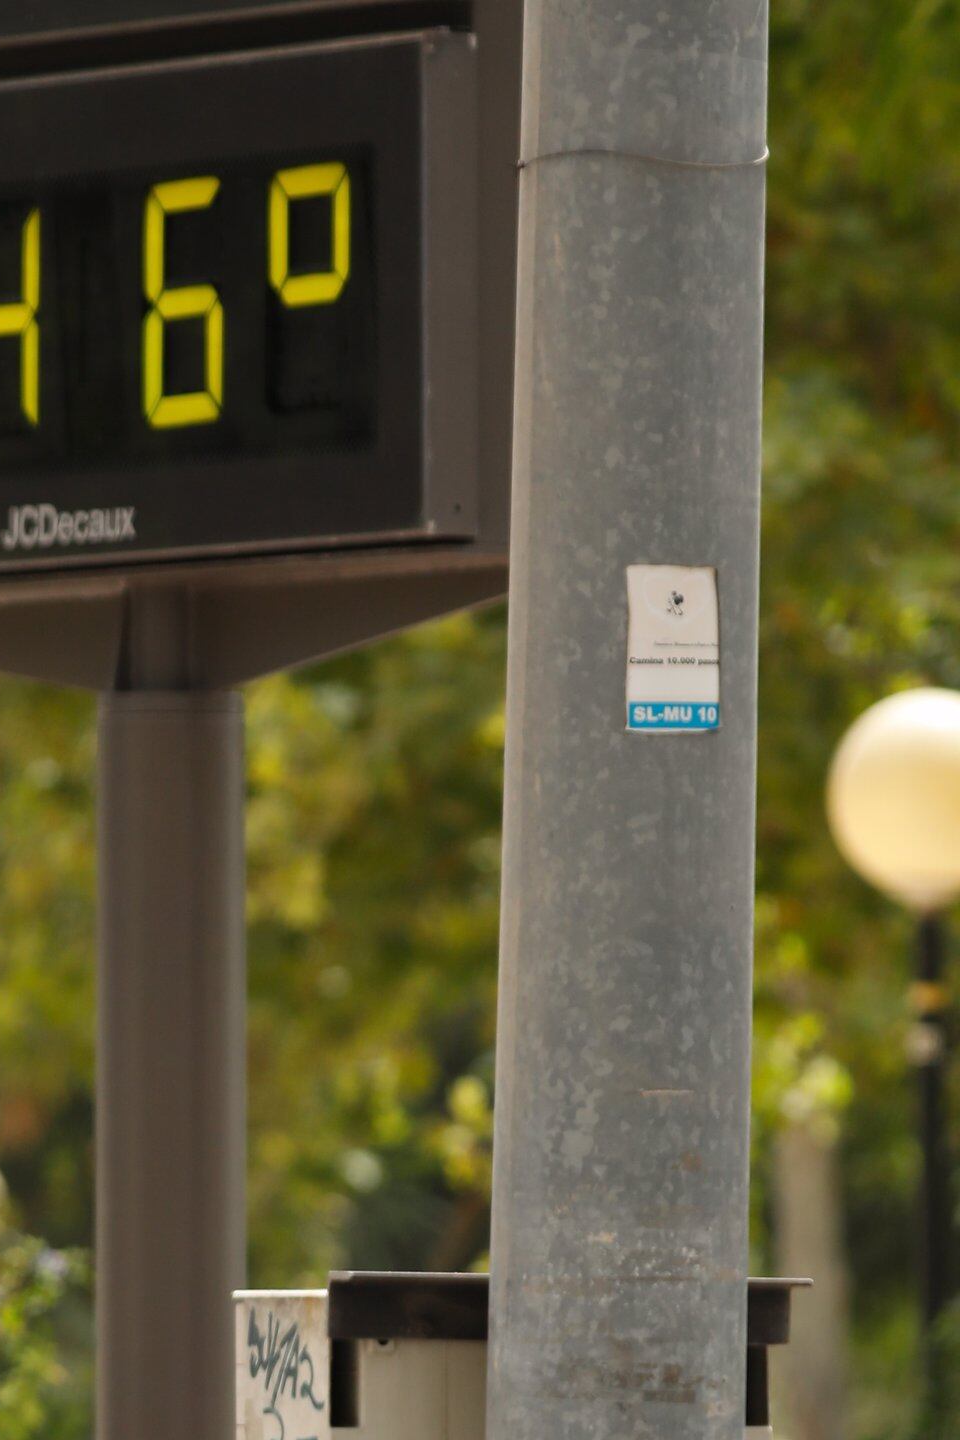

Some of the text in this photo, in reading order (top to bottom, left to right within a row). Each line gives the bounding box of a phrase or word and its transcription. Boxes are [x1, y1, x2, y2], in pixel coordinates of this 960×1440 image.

[0, 503, 137, 550] JCDecaux
[633, 705, 718, 723] SL-MU 10
